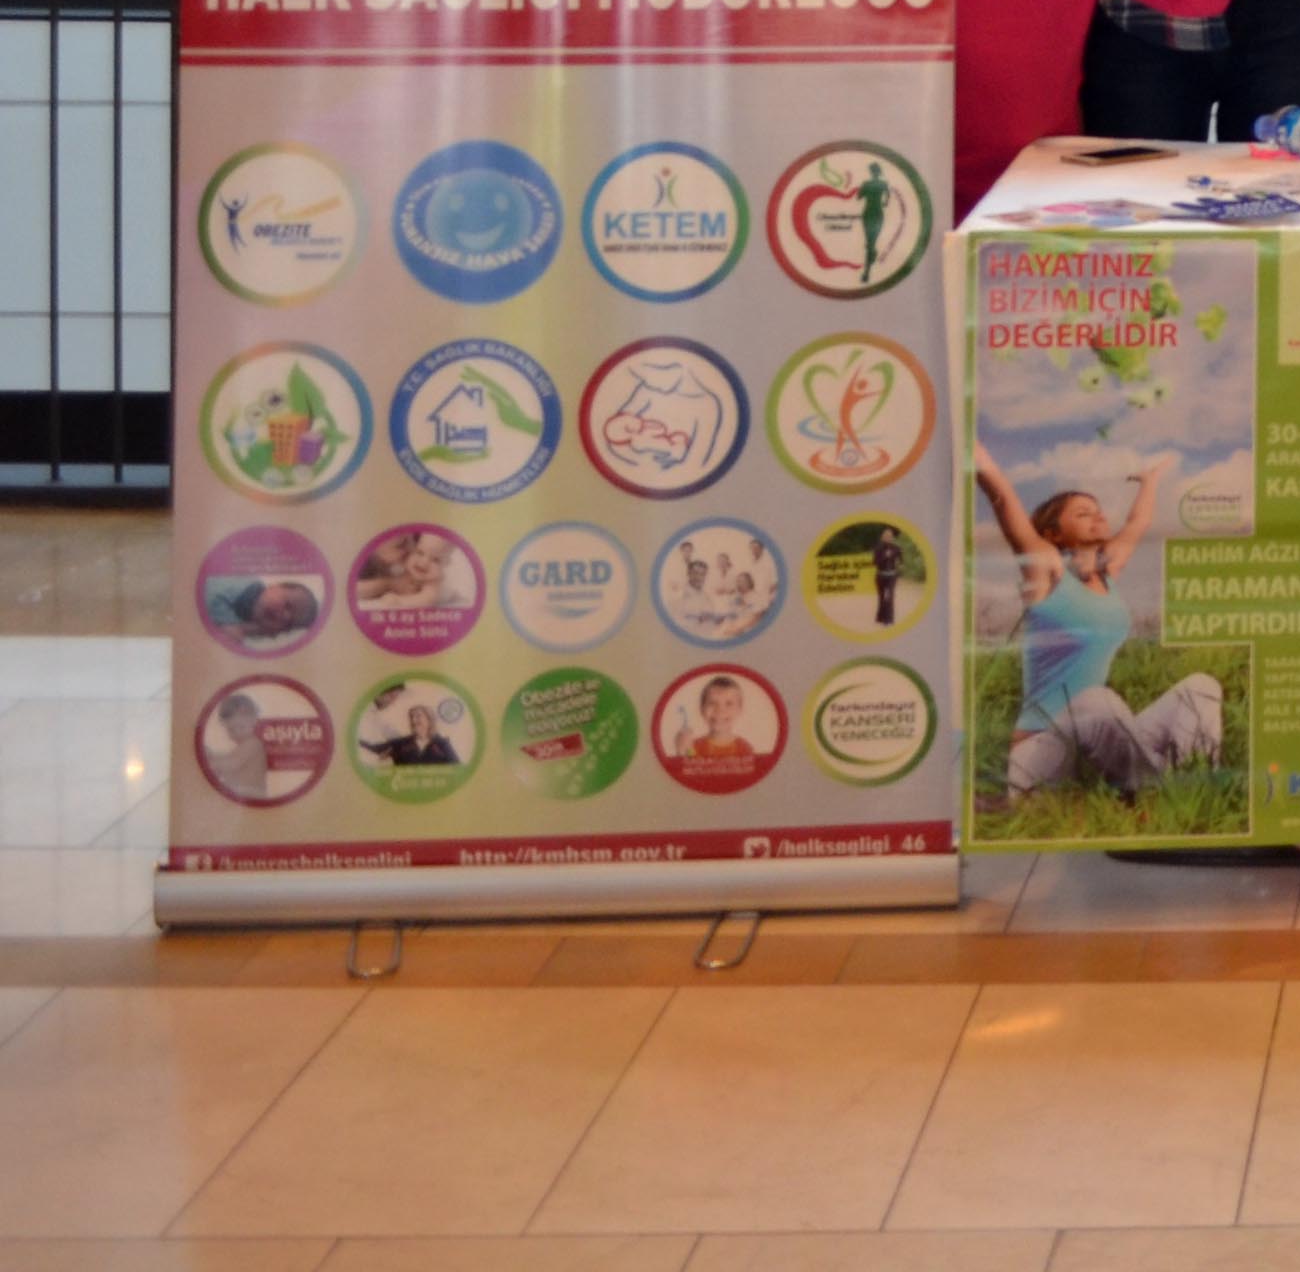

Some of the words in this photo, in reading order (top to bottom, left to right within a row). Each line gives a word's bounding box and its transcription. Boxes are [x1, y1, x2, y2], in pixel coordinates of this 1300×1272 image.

[603, 211, 727, 239] KETEM
[988, 253, 1154, 279] HAYATINIZ
[988, 284, 1078, 314] BİZİM
[1089, 283, 1152, 320] İÇİN
[987, 319, 1179, 349] DEĞERLİDİR
[519, 560, 612, 586] GARD
